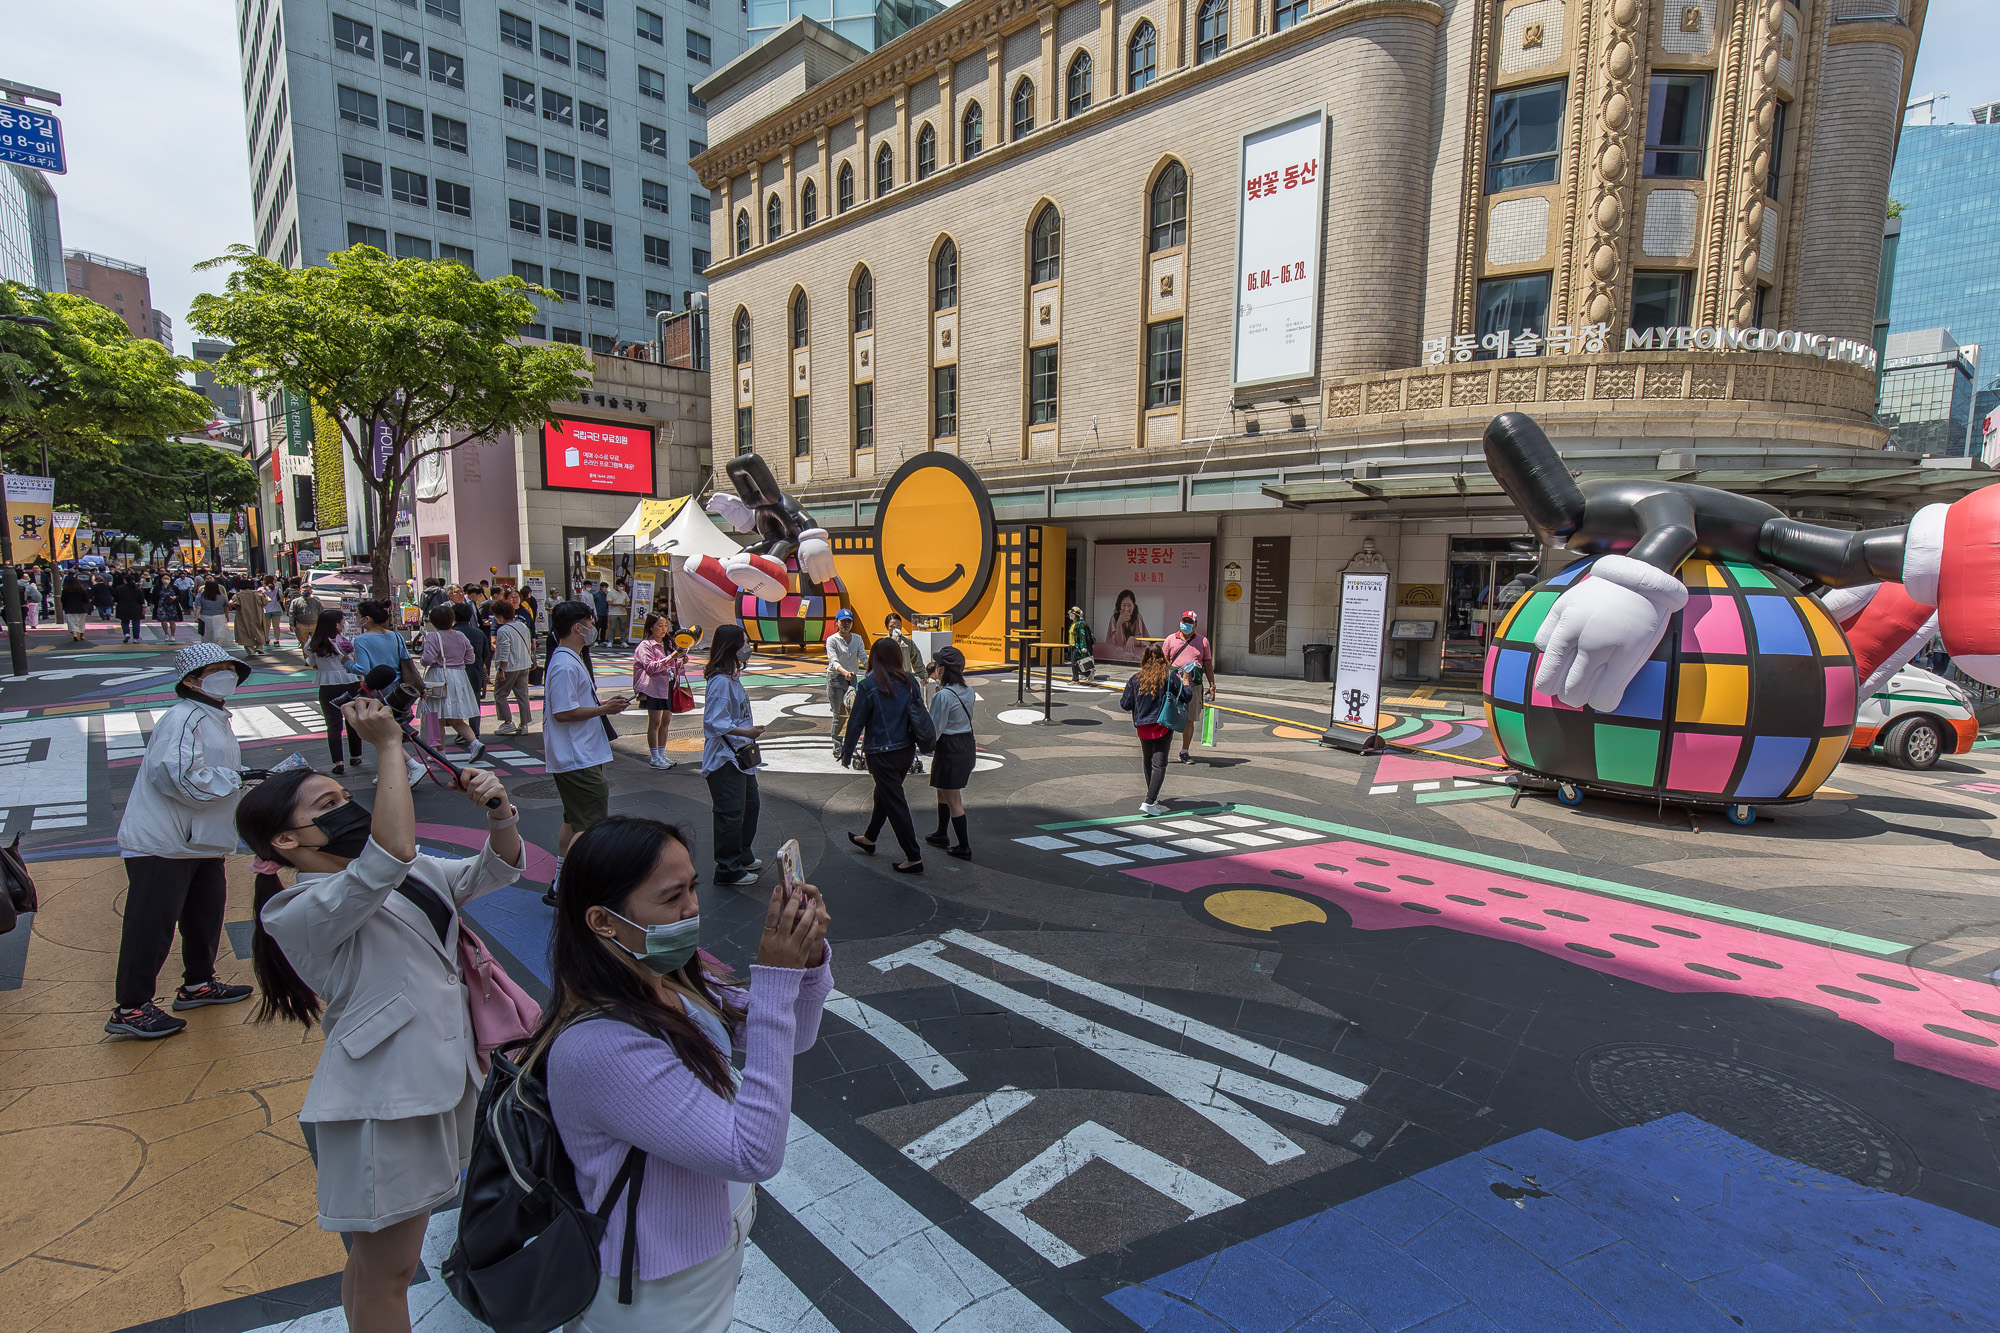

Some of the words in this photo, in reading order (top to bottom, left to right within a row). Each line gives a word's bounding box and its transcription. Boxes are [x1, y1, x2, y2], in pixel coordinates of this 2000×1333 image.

[17, 136, 55, 153] 8-gil
[1247, 170, 1279, 201] 벚꽃
[1283, 158, 1318, 190] 동산
[1422, 322, 1610, 364] 명동예술극장
[1625, 326, 1827, 356] MYEONGDONG
[291, 409, 302, 448] REPUBLIC
[573, 430, 600, 442] 국립극단
[602, 434, 628, 445] 무료회원
[1127, 548, 1148, 564] 벚꽃
[1151, 548, 1174, 564] 동산
